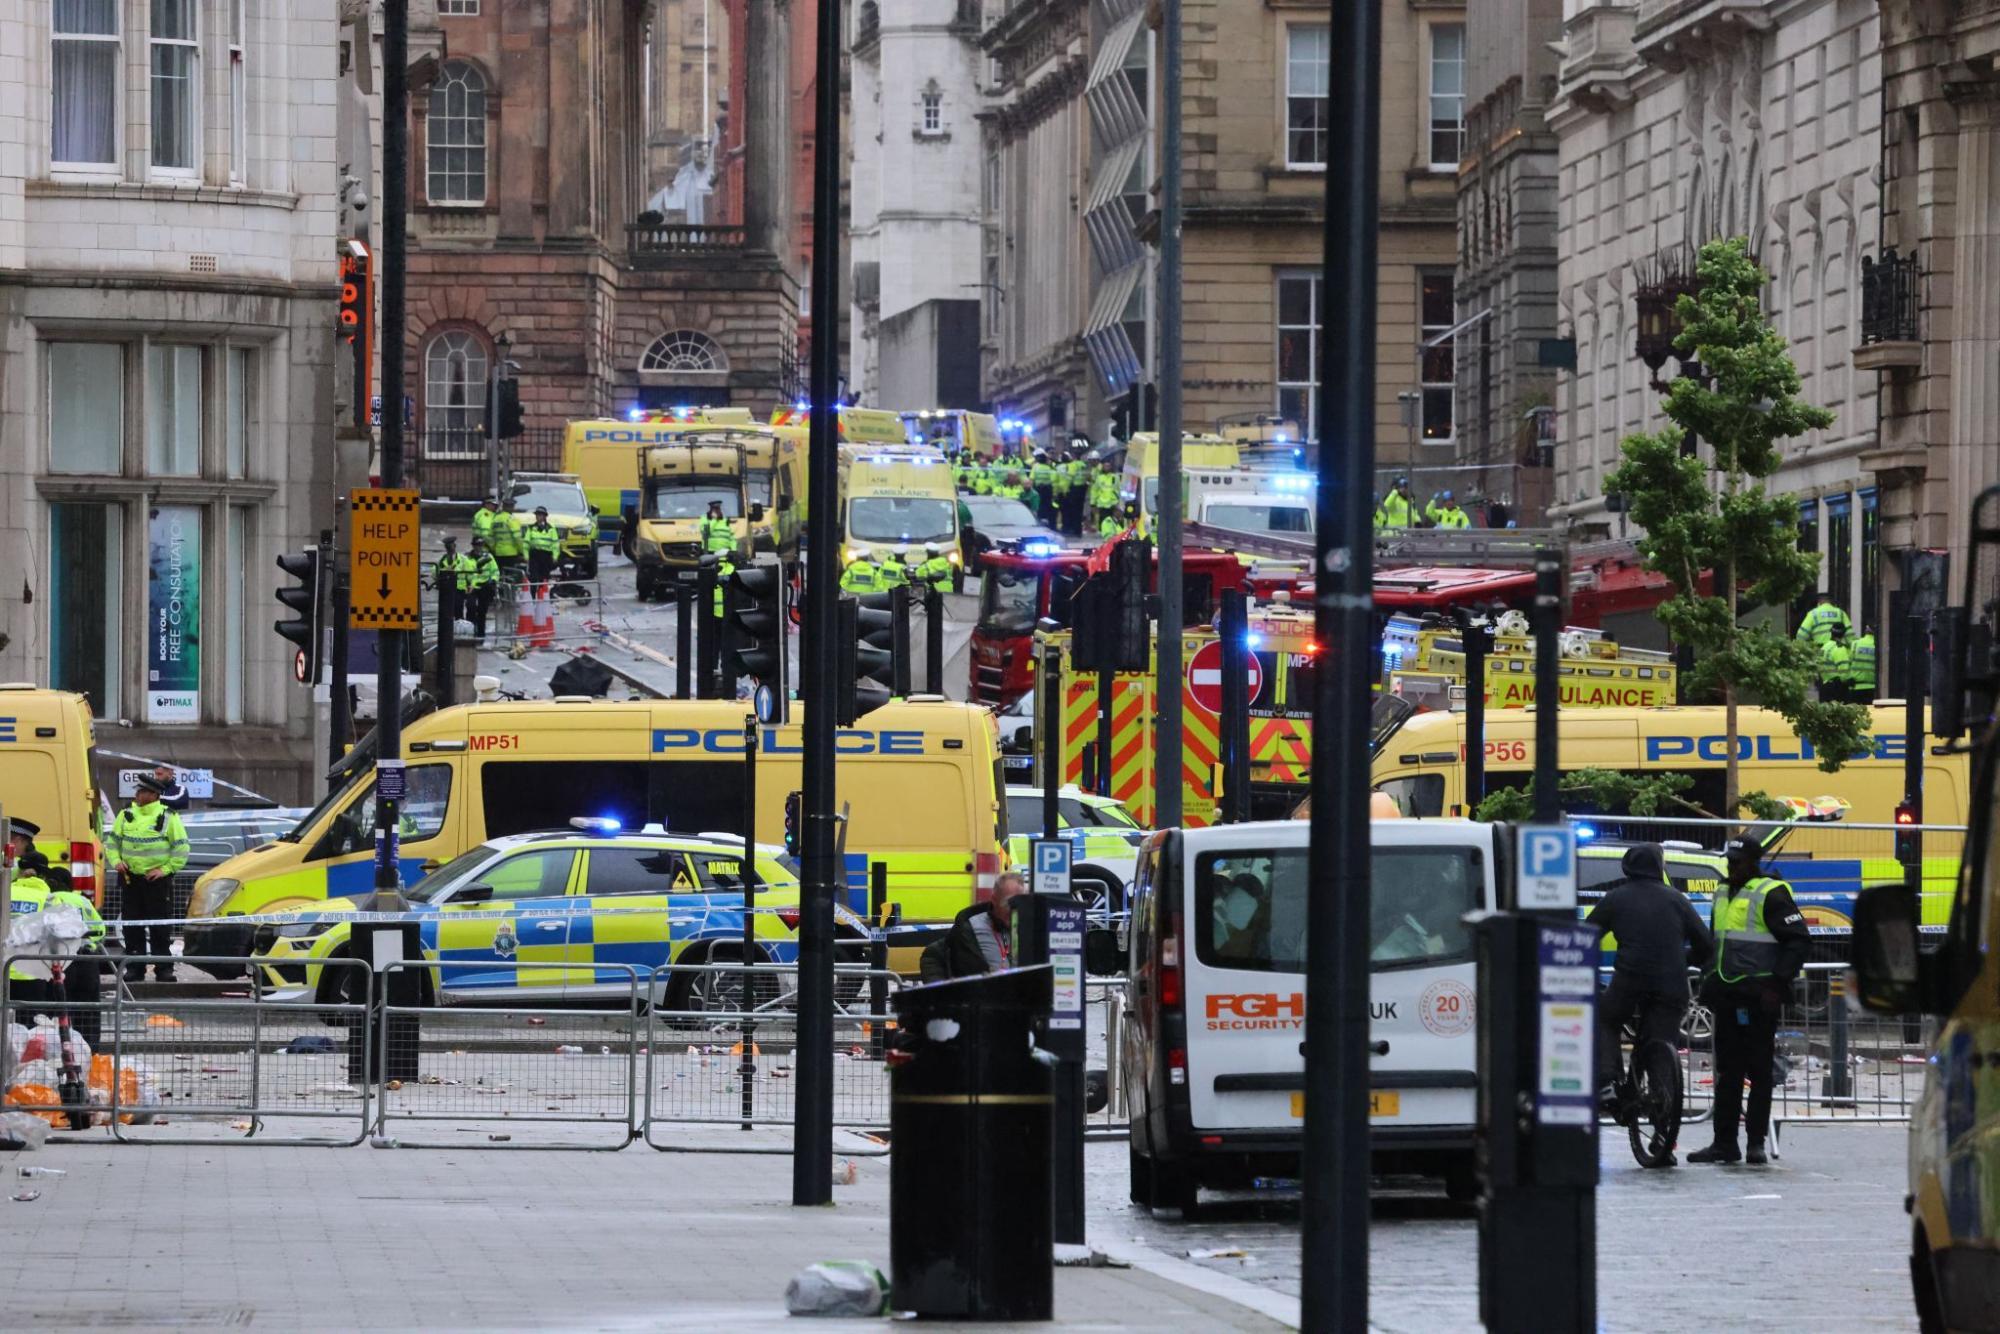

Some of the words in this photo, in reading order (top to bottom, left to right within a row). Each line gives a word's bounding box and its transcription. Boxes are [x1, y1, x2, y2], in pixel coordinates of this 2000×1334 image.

[363, 523, 409, 539] HELP
[169, 509, 183, 625] CONSULTATION
[358, 550, 413, 567] POINT
[159, 607, 167, 635] YOUR
[1252, 621, 1315, 635] POLICE
[159, 638, 167, 661] BOOK
[170, 634, 182, 662] FREE
[1505, 683, 1654, 708] AMULANCE
[469, 734, 520, 751] MP51
[652, 729, 924, 753] POLCE
[1043, 847, 1062, 872] P
[1533, 835, 1563, 874] P
[707, 860, 740, 875] MATRIX
[1045, 874, 1059, 883] Pay
[1537, 879, 1558, 892] Pay
[1687, 879, 1718, 892] MATRIX
[10, 902, 38, 913] OLICE
[1050, 908, 1068, 920] Pay
[1069, 909, 1081, 920] by
[1056, 921, 1075, 931] app
[1541, 929, 1571, 948] Pay
[1573, 929, 1595, 949] by
[1553, 949, 1584, 965] app
[1205, 992, 1304, 1019] FGH
[1436, 995, 1460, 1012] 20
[1206, 1019, 1304, 1031] SECURITY
